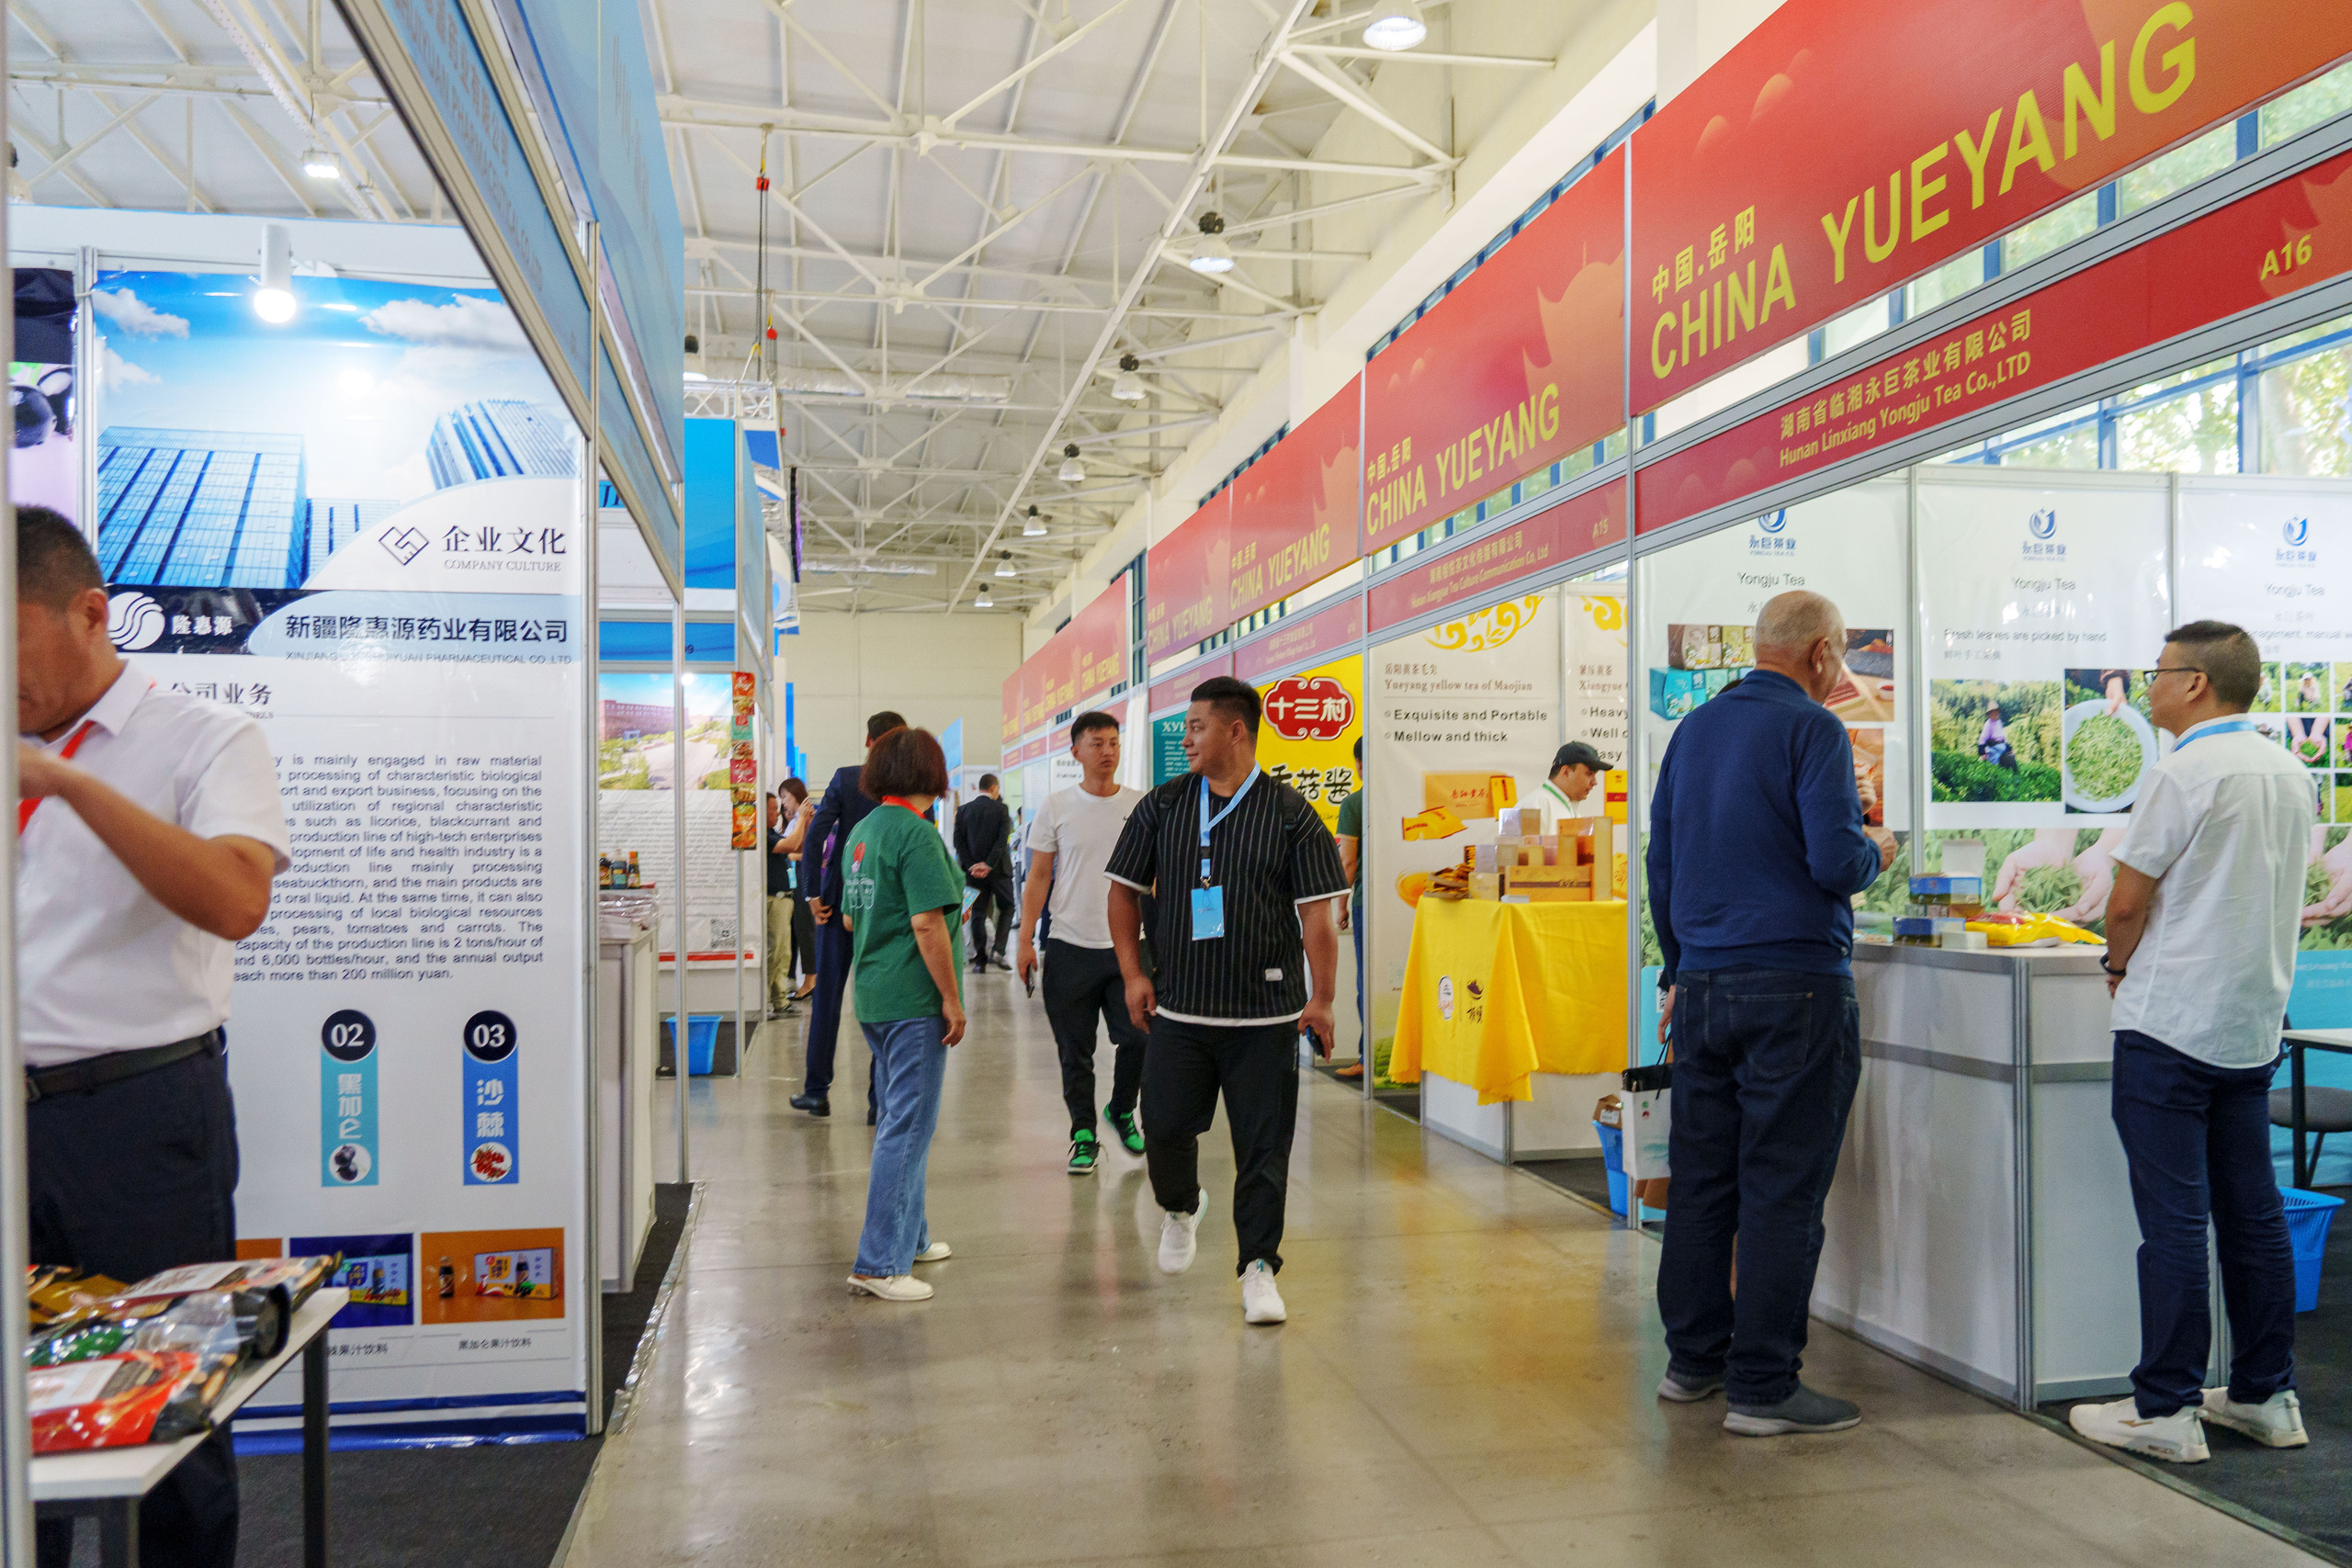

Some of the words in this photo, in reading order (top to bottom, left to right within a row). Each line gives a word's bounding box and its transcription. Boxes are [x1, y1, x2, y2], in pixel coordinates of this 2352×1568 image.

[1651, 243, 1797, 380] CHINA
[1821, 1, 2196, 284] YUEYANG
[2259, 234, 2312, 280] A16
[1781, 309, 2031, 441] 湖南省临湘永巨茶业有限公司
[1780, 441, 1818, 468] Hunan
[1822, 417, 1875, 452] Linxiang
[1880, 393, 1930, 429] Yongju
[1934, 379, 1962, 407] Tea
[1966, 351, 2031, 395] Co.,LTD
[1367, 464, 1427, 536] CHINA
[1435, 382, 1560, 497] YUEYANG
[1592, 518, 1609, 538] A15
[442, 525, 567, 555] 企业文化
[444, 559, 503, 570] COMPANY
[506, 560, 561, 571] CULTURE
[1230, 563, 1264, 610] CHINA
[1268, 522, 1330, 591] YUEYANG
[1737, 571, 1780, 588] Yongju
[1783, 573, 1805, 586] Tea
[2012, 577, 2052, 592] Yongju
[2055, 578, 2075, 591] Tea
[286, 615, 567, 643] 新疆隆惠源药业有限公司
[425, 653, 526, 664] PHARMACEUTICAL
[1385, 679, 1428, 692] Yueyang
[1430, 680, 1462, 692] yellow
[1464, 681, 1479, 690] tea
[1481, 680, 1493, 690] of
[1495, 681, 1532, 694] Maojian
[1578, 680, 1623, 694] Xiangyue
[1268, 695, 1348, 722] 十三村
[1394, 709, 1459, 722] Exquisite
[1462, 710, 1487, 721] and
[1490, 710, 1547, 721] Portable
[1394, 731, 1442, 742] Mellow
[1445, 731, 1470, 742] and
[1474, 731, 1508, 742] thick
[1590, 728, 1619, 739] Well
[292, 753, 305, 764] is
[313, 753, 358, 768] mainly
[367, 754, 425, 768] engaged
[435, 754, 447, 765] in
[456, 757, 481, 765] raw
[490, 754, 543, 766] material
[1599, 750, 1623, 762] asy
[288, 770, 361, 783] processing
[367, 769, 381, 780] of
[386, 770, 475, 781] characteristic
[481, 770, 542, 784] biological
[302, 784, 328, 795] and
[331, 784, 374, 797] export
[377, 784, 440, 796] business,
[443, 784, 499, 798] focusing
[502, 787, 518, 795] on
[521, 785, 543, 796] the
[291, 800, 356, 811] utilization
[367, 799, 381, 811] of
[391, 800, 445, 814] regional
[455, 800, 543, 811] characteristic
[304, 816, 337, 827] such
[345, 818, 362, 827] as
[369, 815, 421, 828] licorice,
[429, 815, 510, 826] blackcurrant
[517, 815, 542, 827] and
[289, 830, 360, 843] production
[363, 830, 387, 841] line
[390, 830, 403, 841] of
[406, 830, 467, 844] high-tech
[469, 830, 543, 843] enterprises
[348, 845, 363, 857] of
[366, 845, 387, 857] life
[390, 846, 415, 857] and
[419, 846, 460, 857] health
[463, 845, 516, 859] industry
[519, 845, 531, 856] is
[534, 847, 543, 856] a
[368, 862, 393, 873] line
[411, 861, 455, 874] mainly
[471, 861, 543, 874] processing
[372, 876, 398, 887] and
[401, 876, 423, 887] the
[425, 876, 458, 887] main
[461, 876, 518, 889] products
[521, 877, 543, 886] are
[285, 892, 311, 903] oral
[314, 892, 355, 905] liquid.
[357, 892, 374, 903] At
[376, 892, 398, 903] the
[401, 894, 438, 903] same
[441, 891, 473, 905] time,
[477, 891, 486, 902] it
[488, 893, 513, 902] can
[515, 891, 544, 902] also
[270, 908, 344, 921] processing
[350, 907, 364, 919] of
[370, 907, 402, 918] local
[409, 907, 472, 920] biological
[479, 908, 544, 917] resources
[292, 925, 334, 936] pears,
[346, 922, 409, 933] tomatoes
[420, 921, 445, 933] and
[457, 922, 506, 933] carrots.
[517, 920, 544, 932] The
[295, 938, 310, 949] of
[311, 938, 334, 949] the
[337, 938, 408, 951] production
[411, 937, 435, 948] line
[438, 937, 450, 948] is
[453, 936, 462, 948] 2
[465, 936, 528, 948] tons/hour
[530, 935, 544, 947] of
[261, 951, 300, 966] 6,000
[306, 953, 390, 964] bottles/hour,
[395, 953, 421, 964] and
[425, 953, 447, 964] the
[452, 952, 497, 963] annual
[502, 951, 544, 964] output
[269, 971, 305, 980] more
[308, 969, 338, 980] than
[341, 968, 368, 980] 200
[370, 968, 414, 979] million
[417, 969, 455, 981] yuan.
[331, 1023, 365, 1047] 02
[473, 1024, 505, 1048] 03
[338, 1073, 363, 1139] 黑加仑
